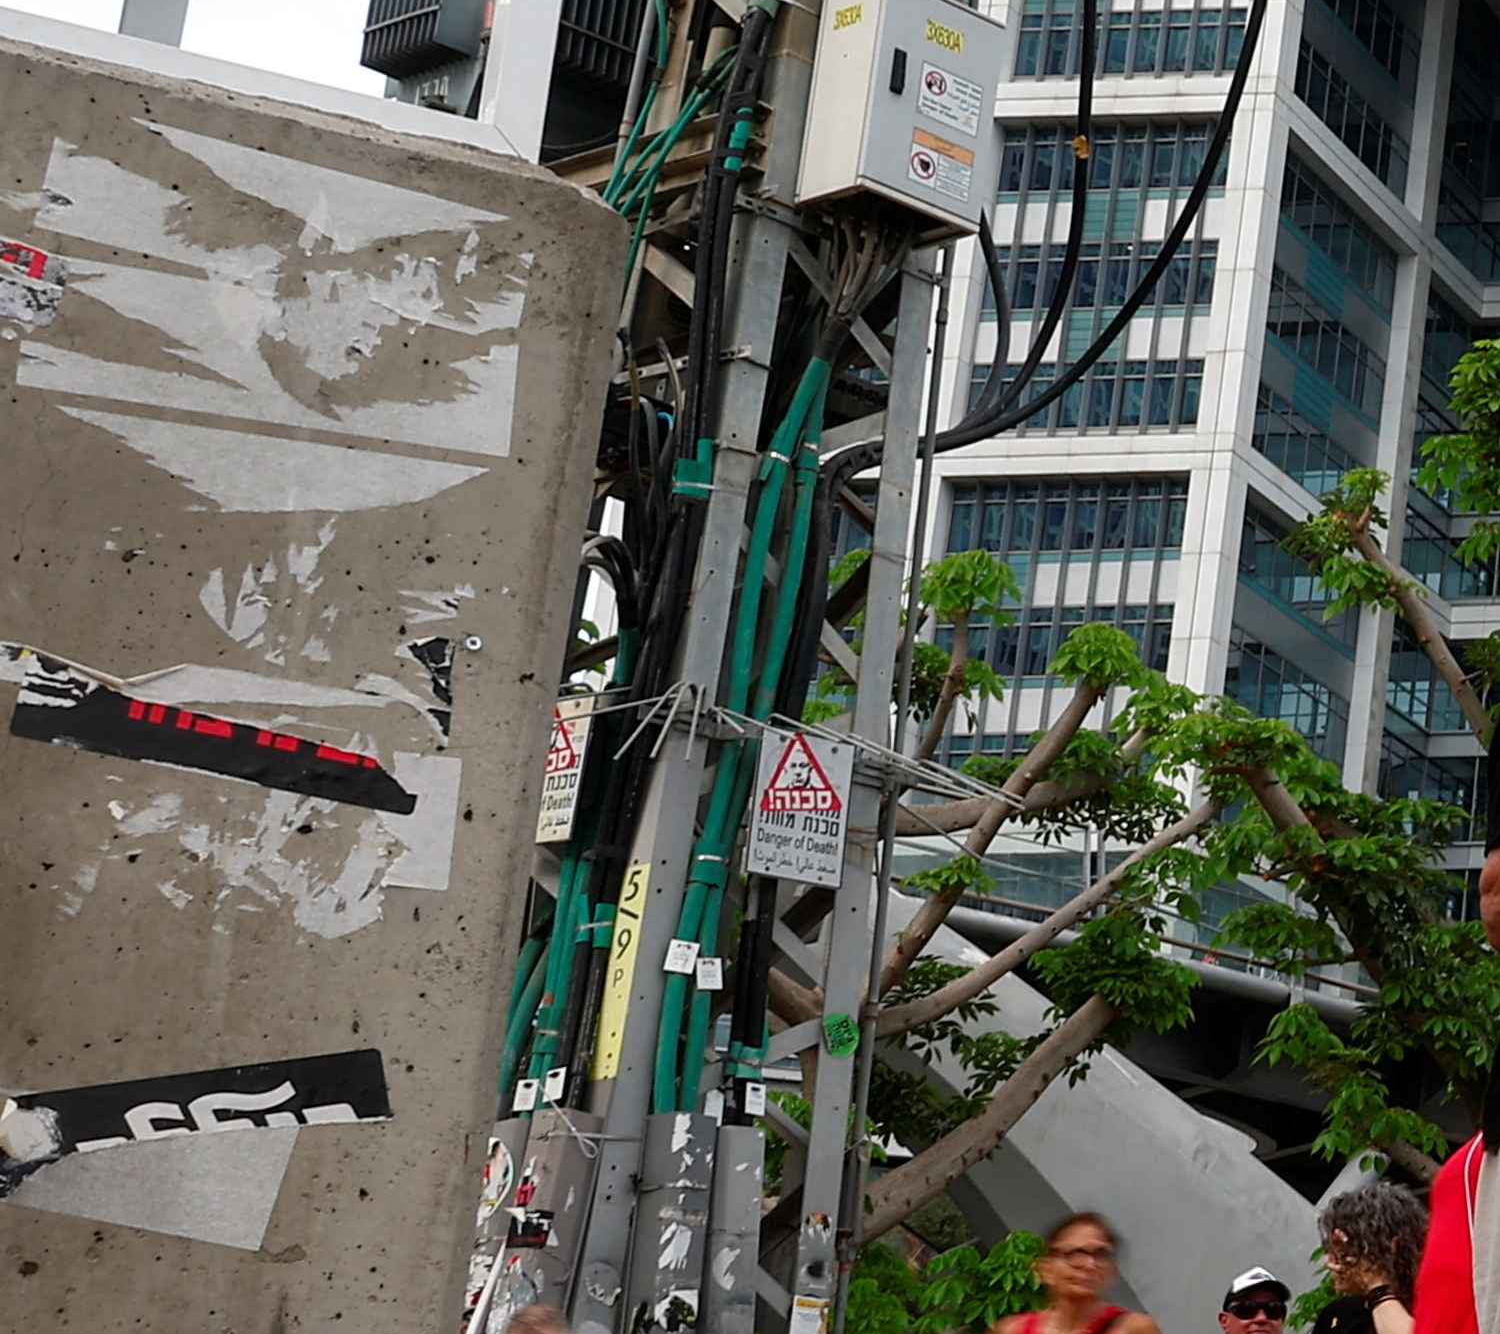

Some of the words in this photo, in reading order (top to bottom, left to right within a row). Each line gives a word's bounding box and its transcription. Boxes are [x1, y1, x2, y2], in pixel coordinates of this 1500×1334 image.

[927, 19, 964, 54] 3X630A
[769, 789, 832, 809] סכנה!
[802, 816, 840, 837] סכנת
[757, 828, 791, 849] Danger
[794, 836, 806, 851] of
[806, 838, 838, 856] Death!
